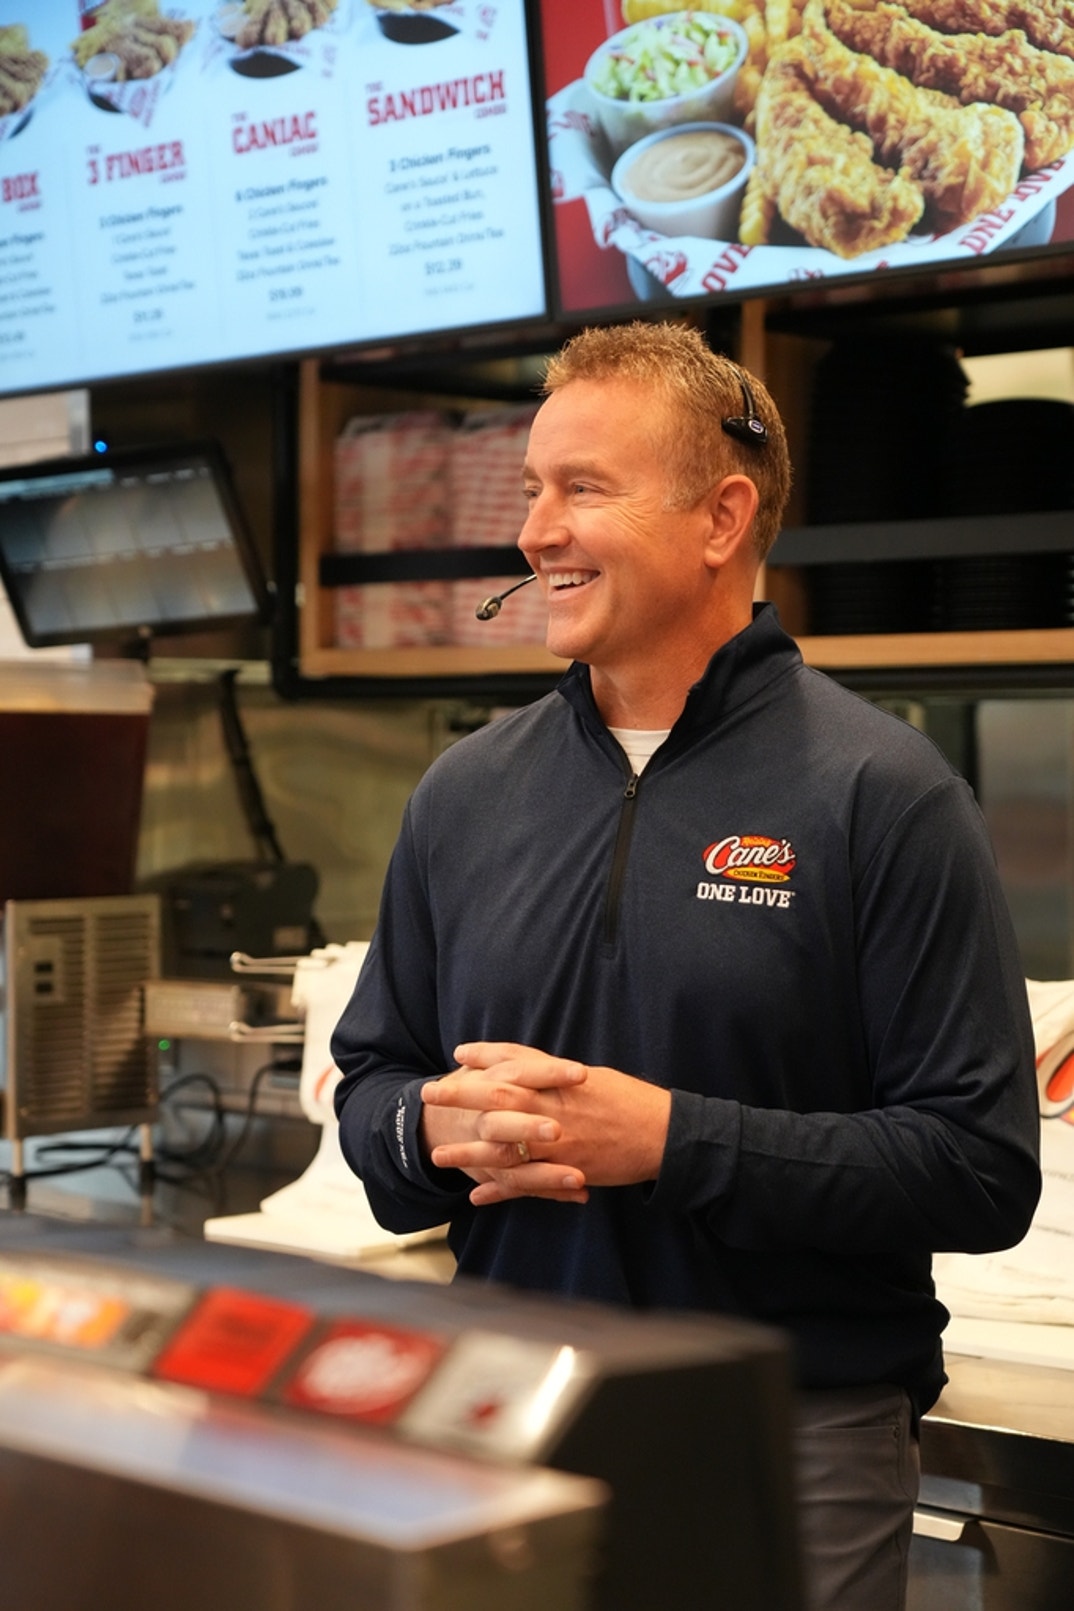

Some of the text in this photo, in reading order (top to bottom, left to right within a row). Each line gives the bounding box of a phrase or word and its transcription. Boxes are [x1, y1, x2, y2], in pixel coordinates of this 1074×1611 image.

[367, 69, 505, 127] SANDWICH
[232, 110, 318, 154] CANIAC
[87, 140, 186, 185] 3 FINGER
[447, 144, 490, 162] Fingers
[2, 172, 41, 203] BOX
[705, 836, 796, 875] Cane's
[696, 882, 736, 902] ONE
